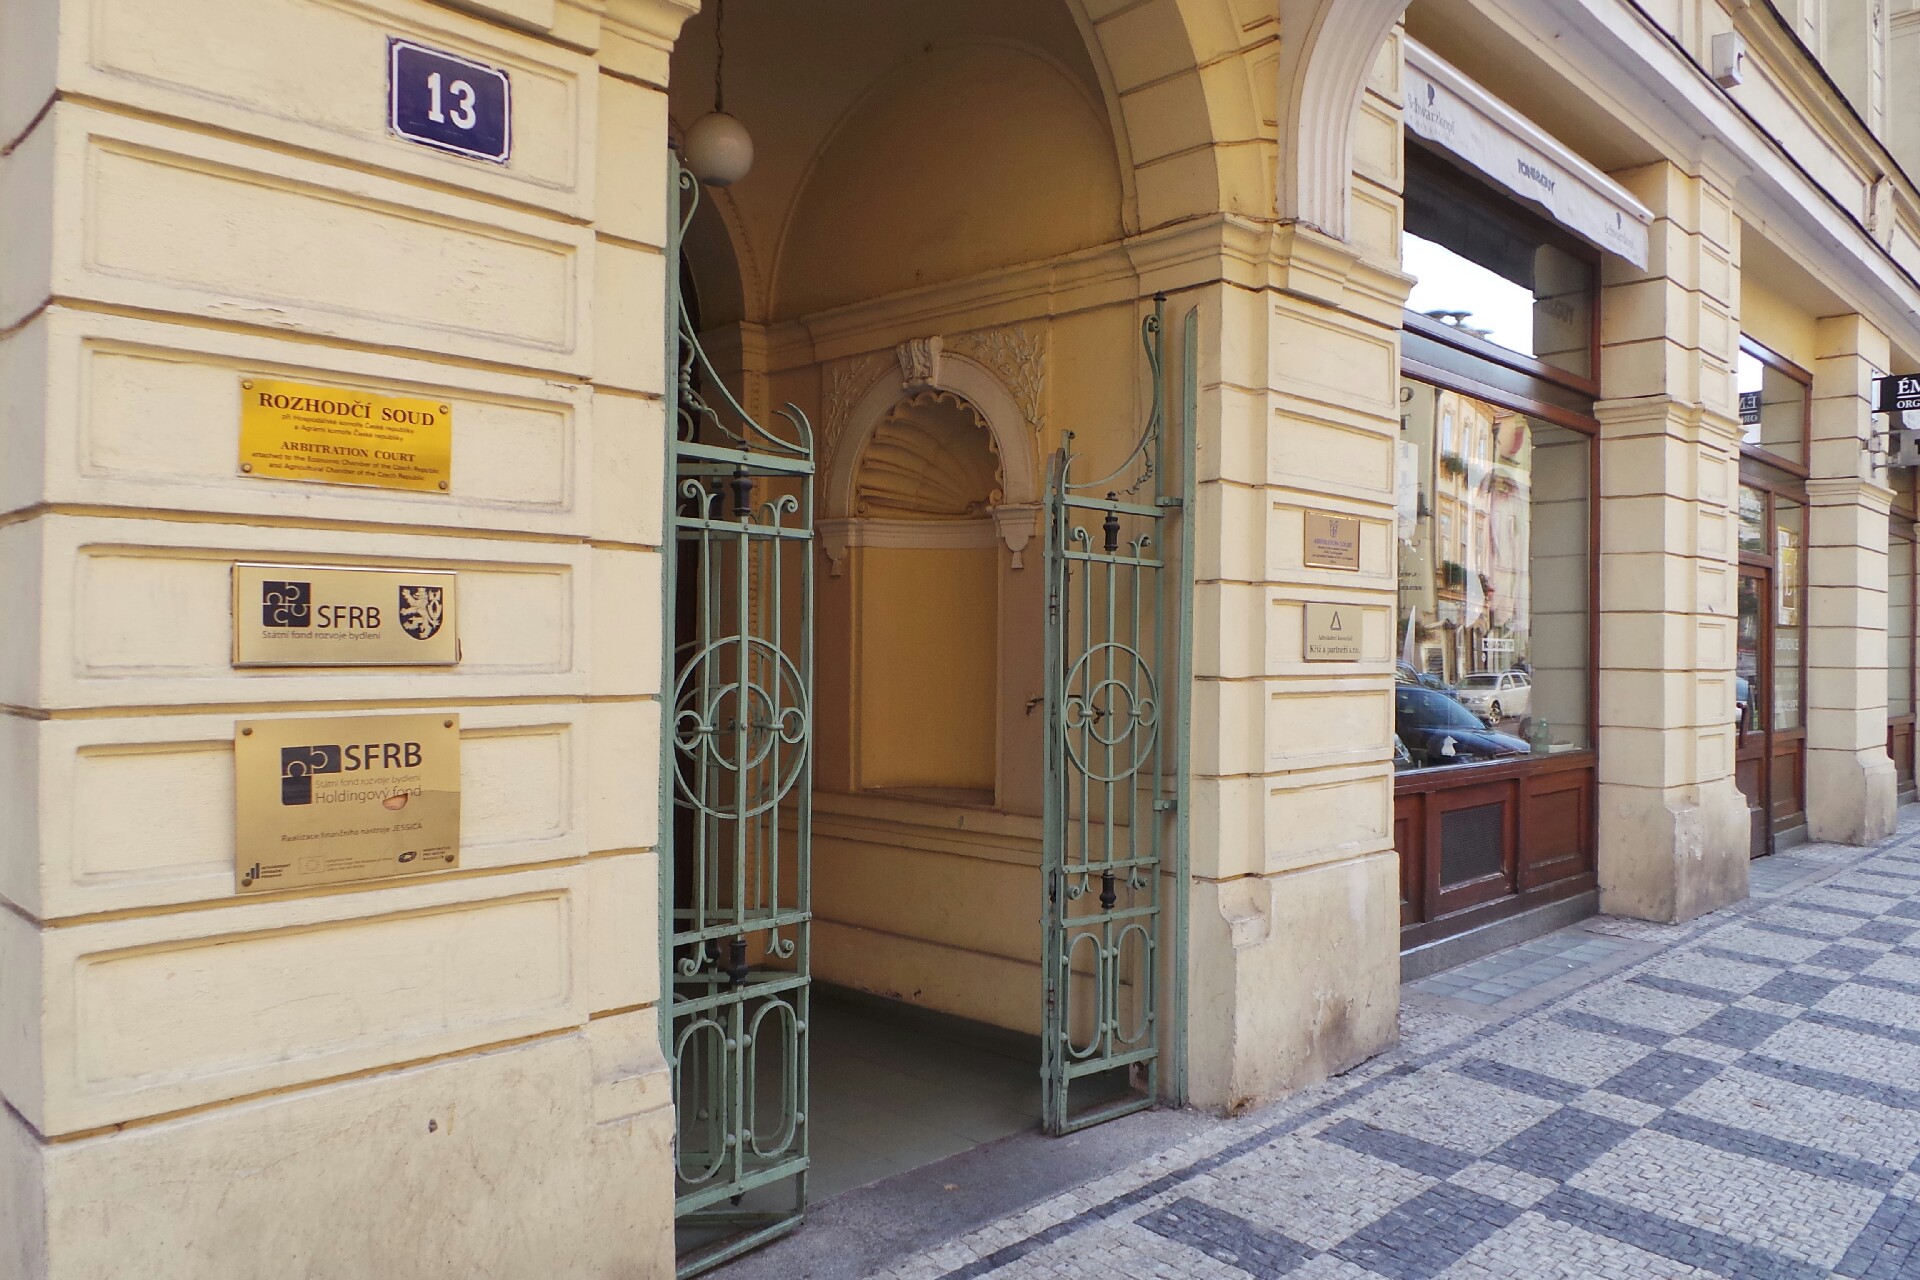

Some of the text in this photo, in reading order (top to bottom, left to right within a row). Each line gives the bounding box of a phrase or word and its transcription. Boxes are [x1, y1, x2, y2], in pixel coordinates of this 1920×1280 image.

[427, 72, 476, 129] 13
[259, 392, 434, 426] ROZHODČÍ SOUD
[281, 441, 415, 462] ARBITRATION COURT
[317, 605, 381, 629] SFRB
[291, 630, 312, 639] fond
[315, 631, 347, 641] rozvoje
[344, 742, 422, 771] SFRB
[316, 786, 390, 804] Holdingový
[392, 822, 423, 832] JESSICA
